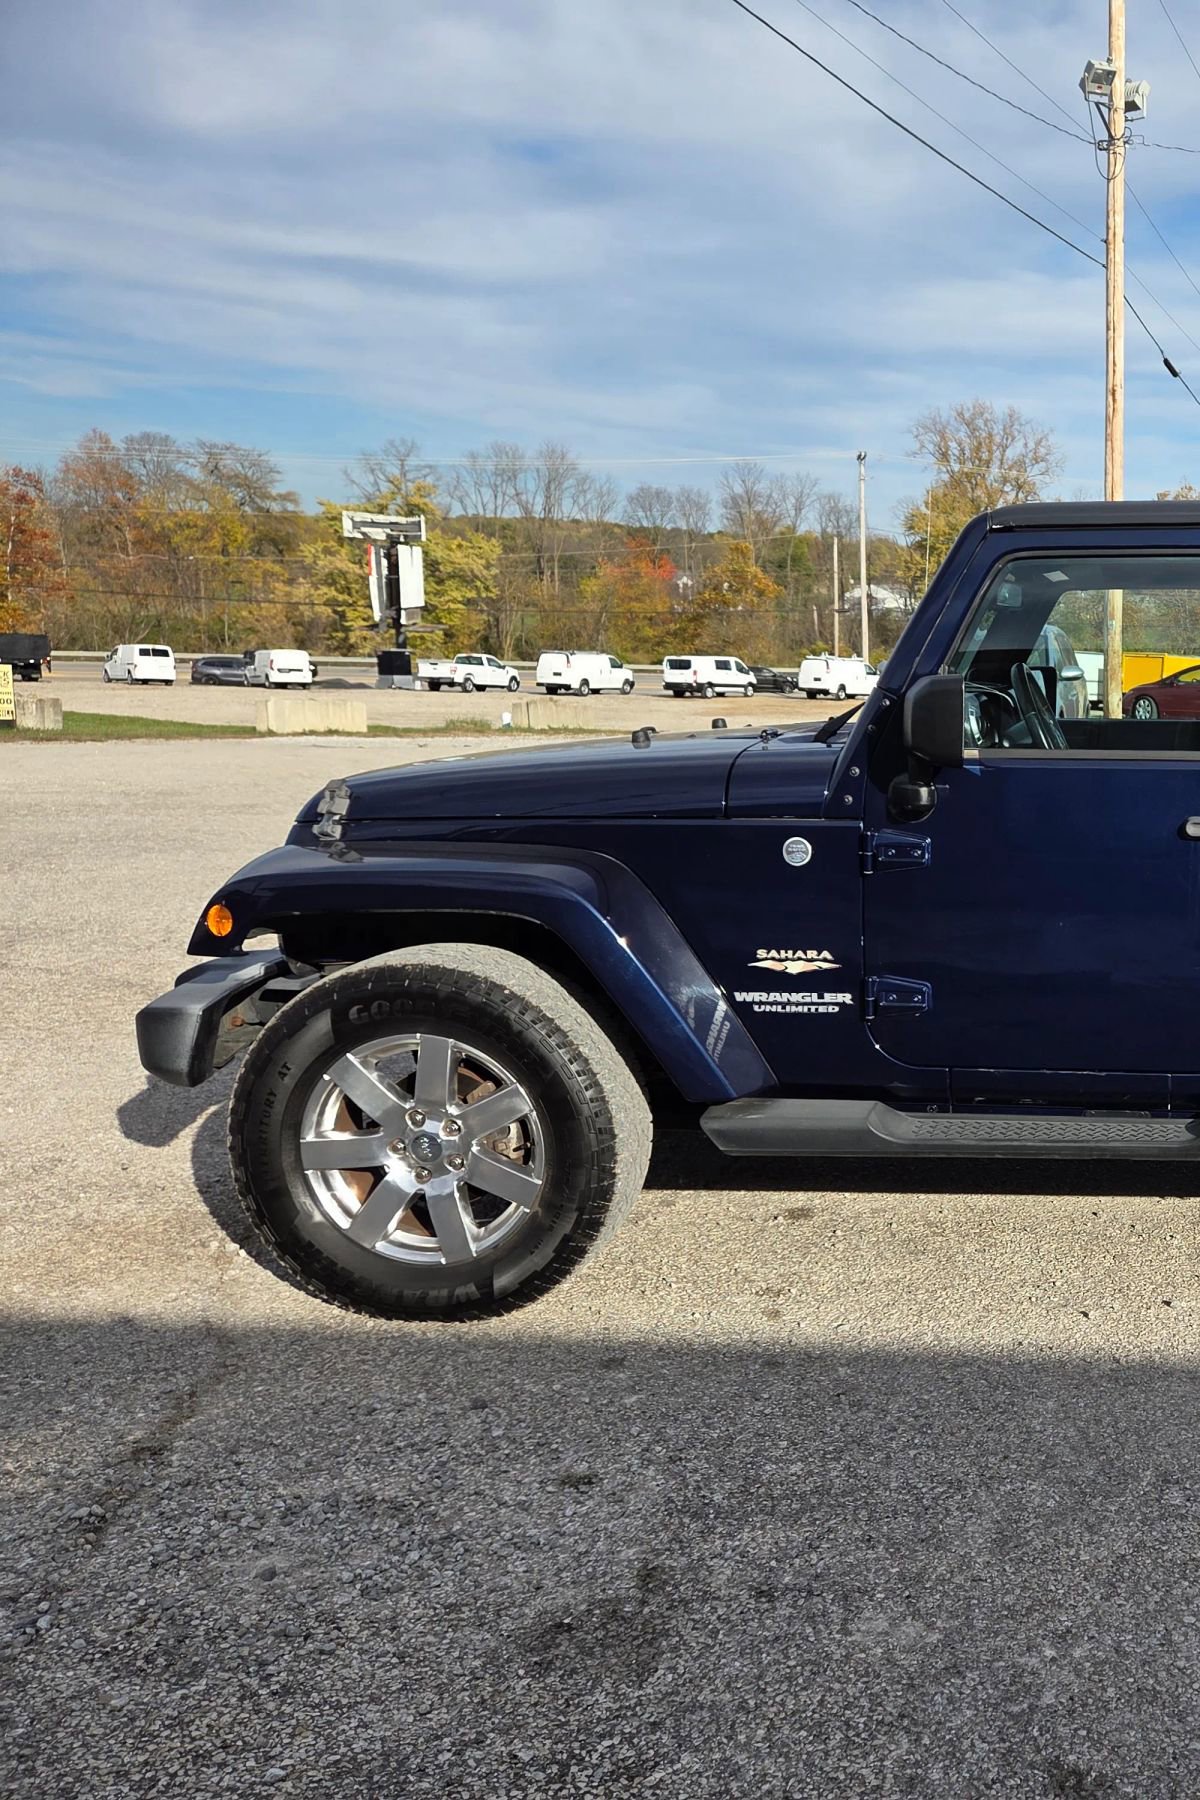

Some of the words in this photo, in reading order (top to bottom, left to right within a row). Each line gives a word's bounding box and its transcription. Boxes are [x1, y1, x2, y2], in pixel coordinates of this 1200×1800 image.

[756, 949, 835, 961] SAHARA
[733, 991, 854, 1005] WRANGLER
[753, 1004, 840, 1013] UNLIMITED
[277, 1061, 293, 1081] AT
